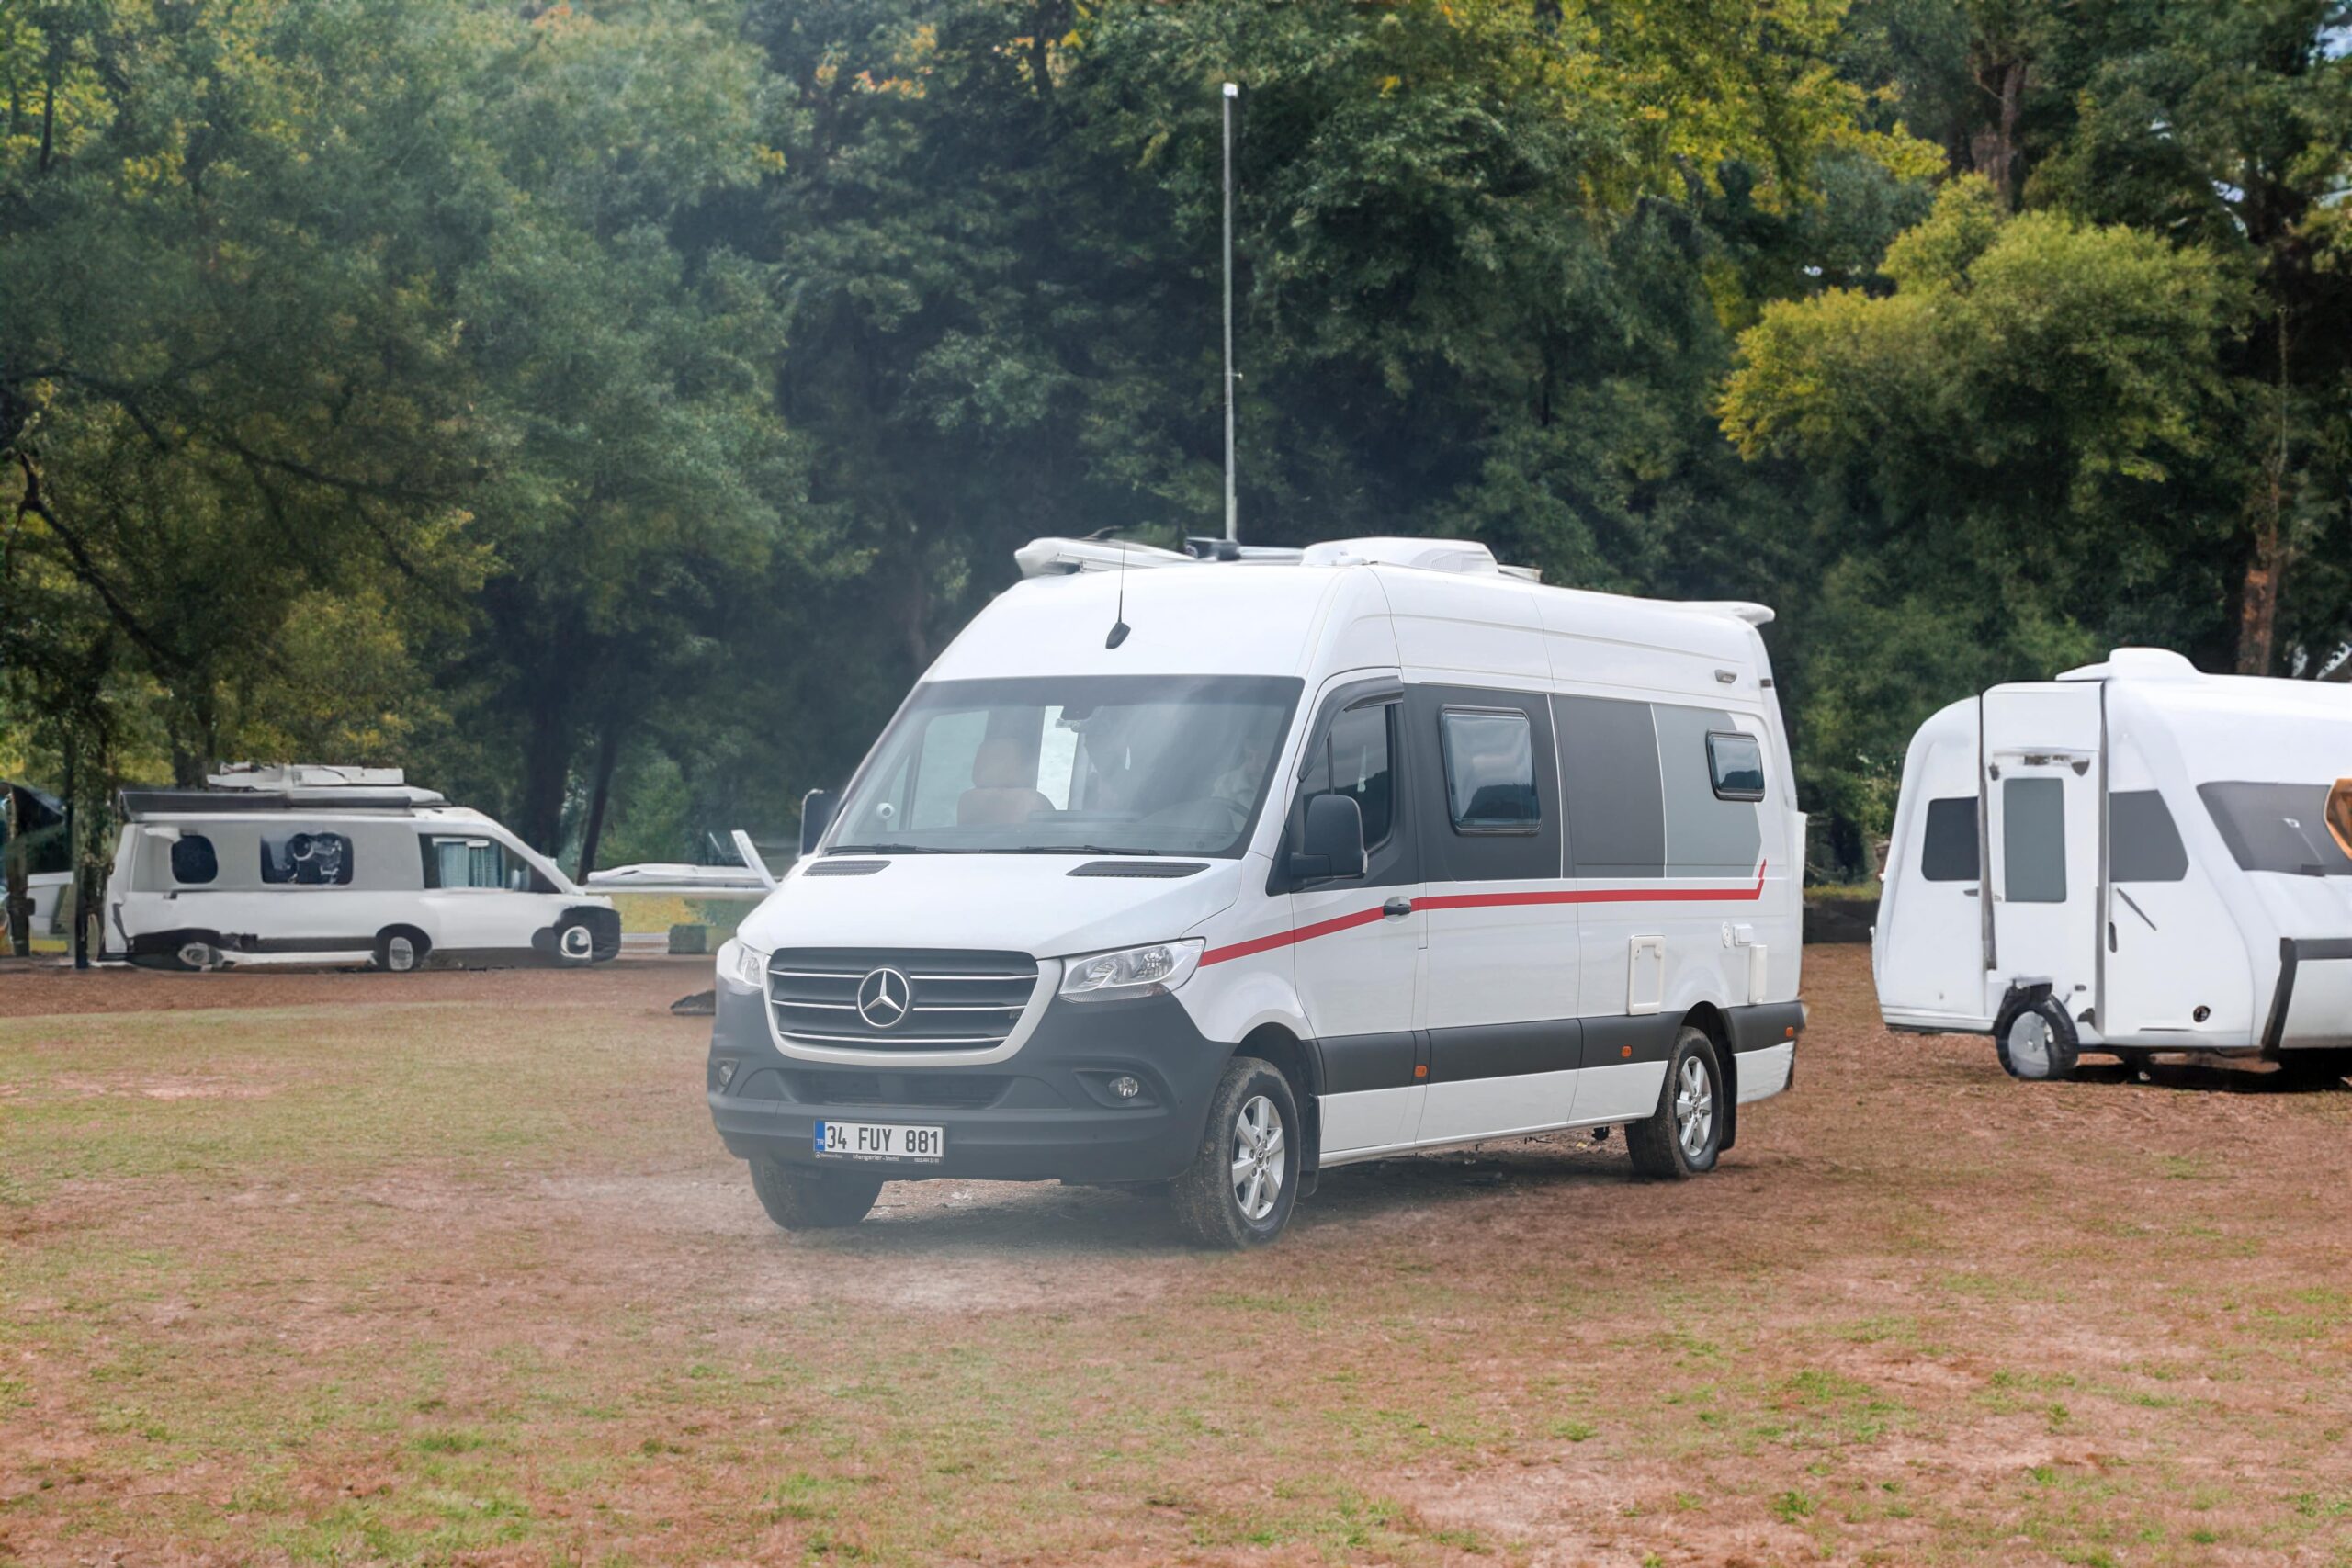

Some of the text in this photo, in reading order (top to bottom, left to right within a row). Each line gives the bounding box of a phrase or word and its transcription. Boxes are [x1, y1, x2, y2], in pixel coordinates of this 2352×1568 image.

[826, 1125, 938, 1154] 34 FUY 881
